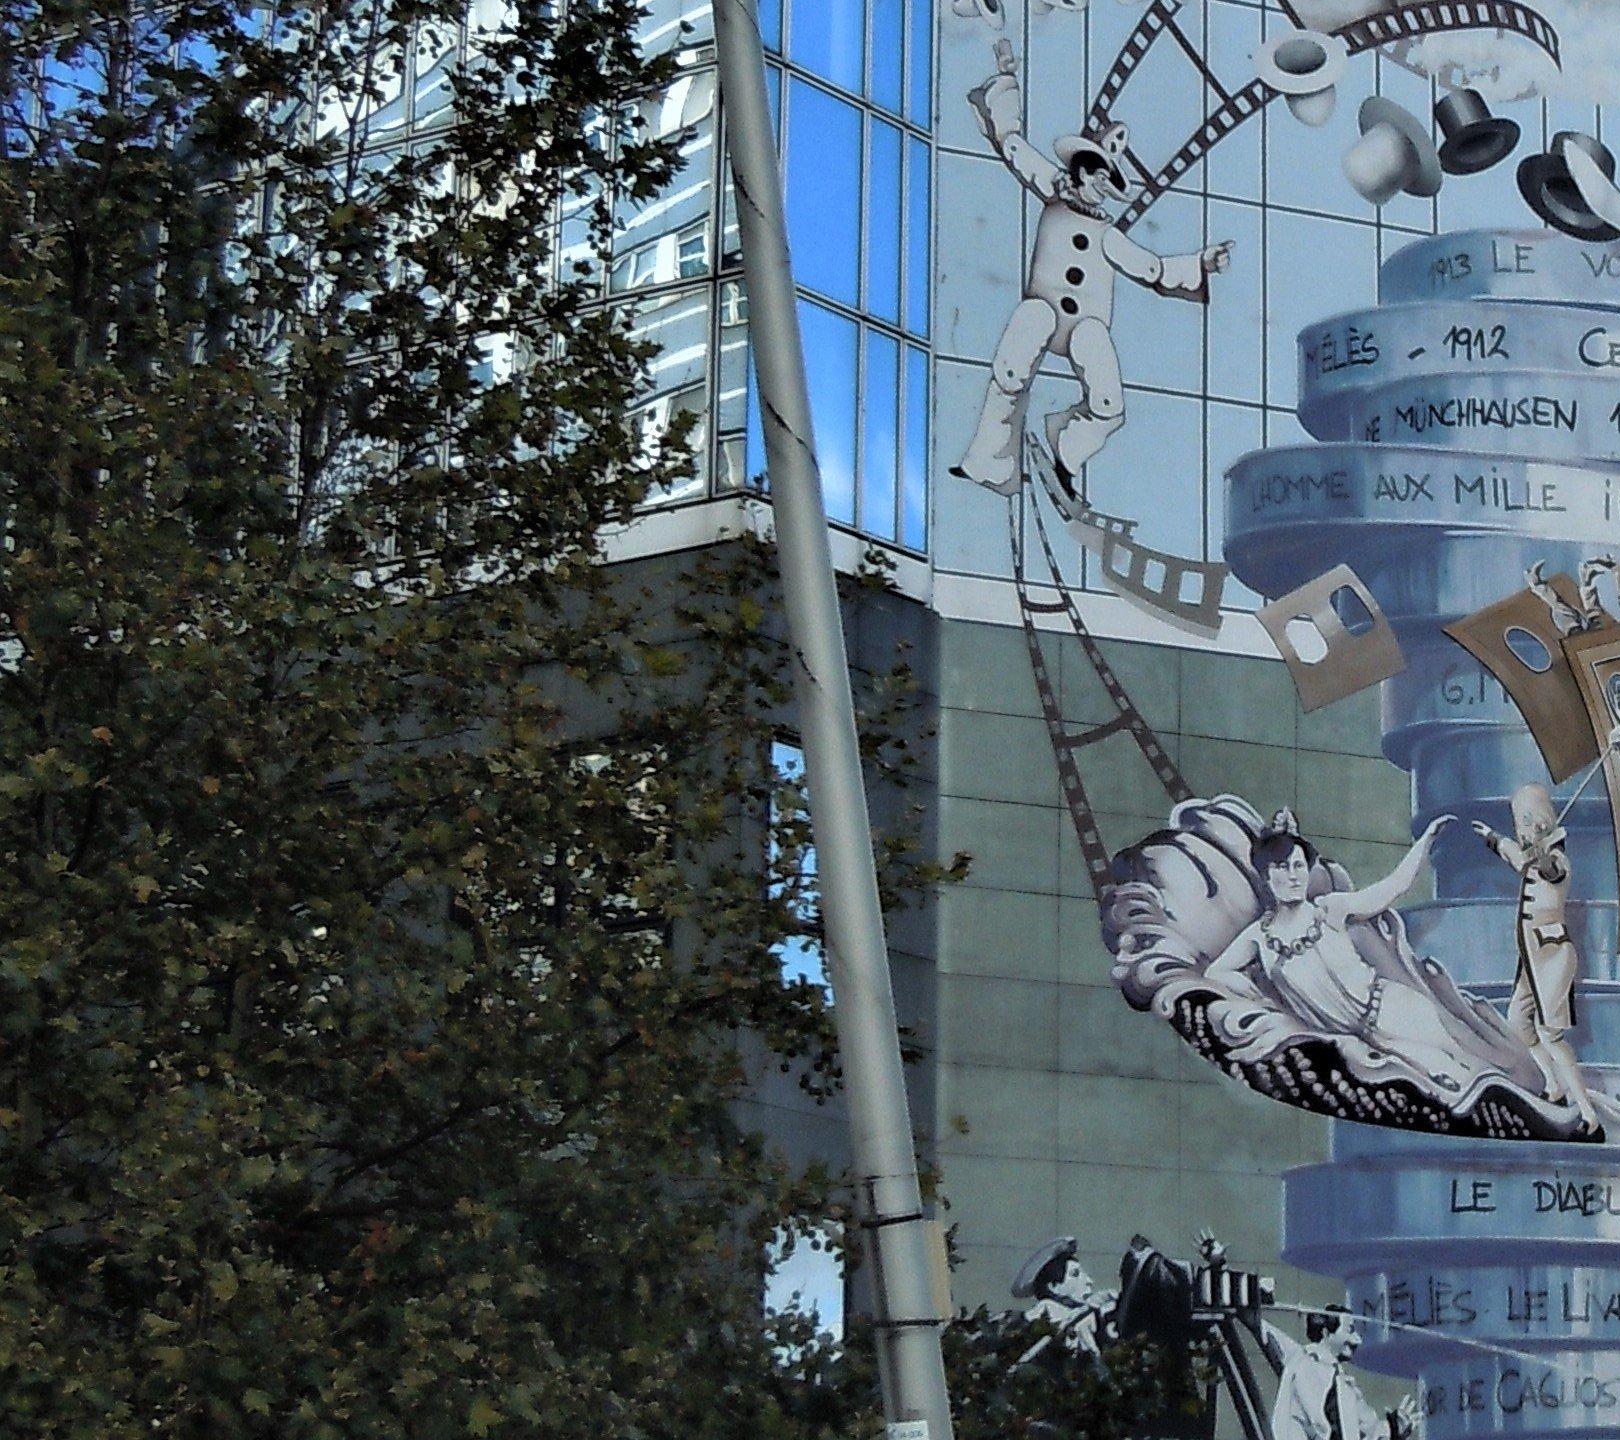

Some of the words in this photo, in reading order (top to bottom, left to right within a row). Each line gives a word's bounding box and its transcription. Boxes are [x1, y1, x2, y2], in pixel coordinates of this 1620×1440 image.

[1491, 239, 1536, 274] LE
[1443, 325, 1509, 362] 1912
[1395, 397, 1578, 432] MÜNCHHAUSEN
[1374, 472, 1434, 502] AUX
[1453, 467, 1567, 512] MILLE
[1451, 1180, 1497, 1213] LE
[1507, 1285, 1548, 1323] LE
